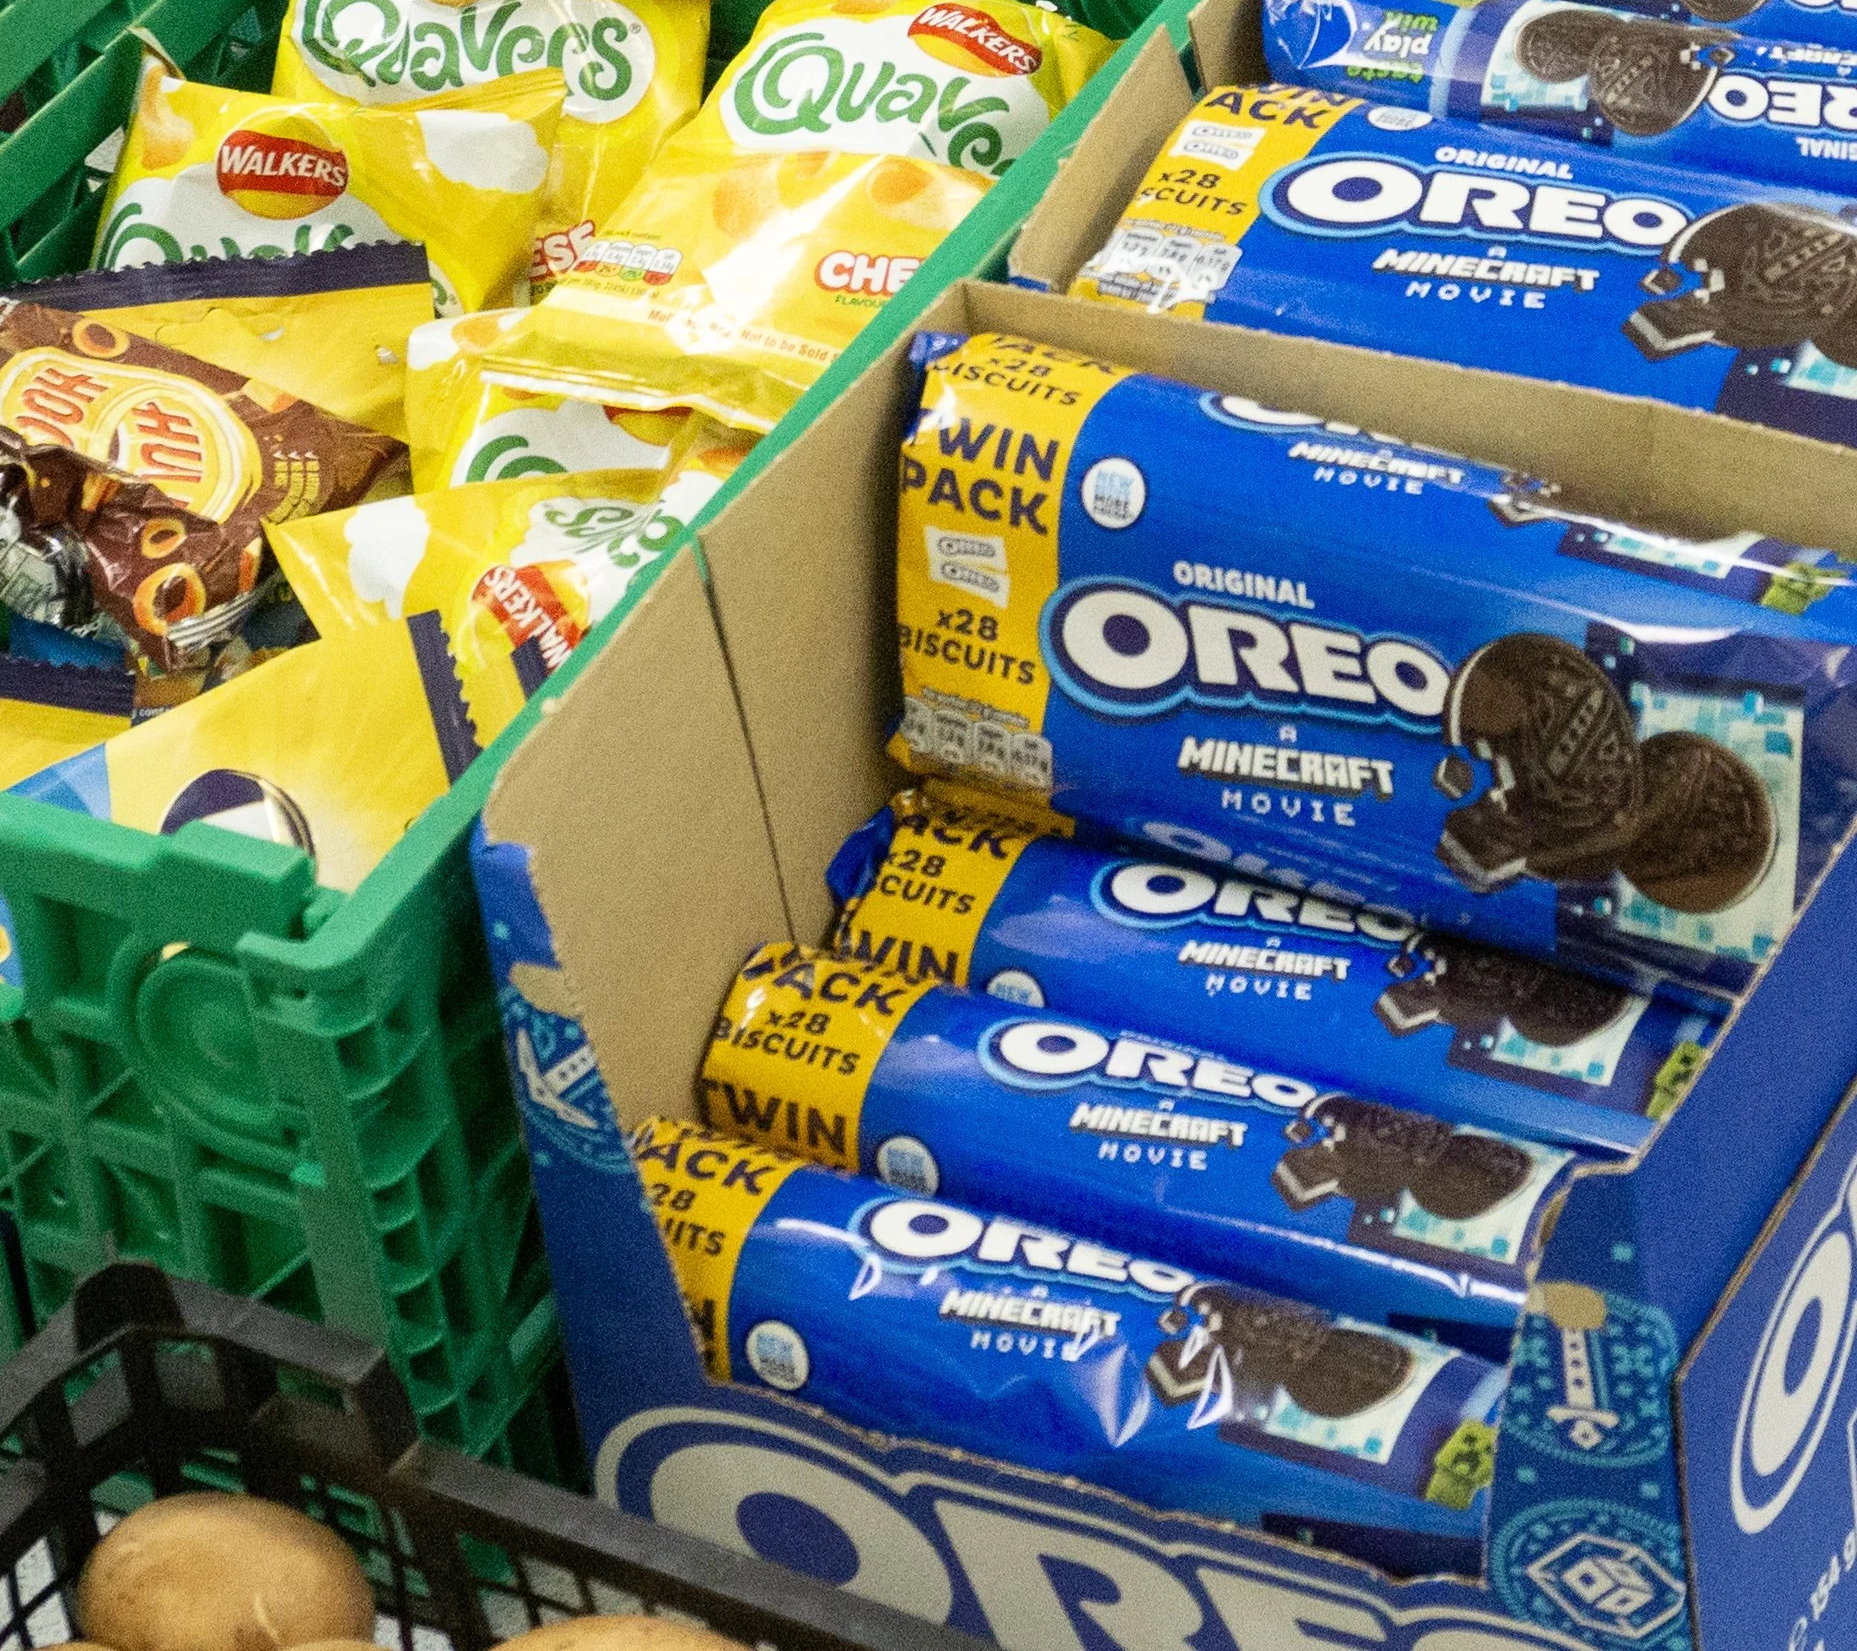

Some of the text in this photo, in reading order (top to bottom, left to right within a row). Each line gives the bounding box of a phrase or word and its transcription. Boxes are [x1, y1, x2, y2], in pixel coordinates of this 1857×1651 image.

[915, 5, 1038, 74] WALKERS
[1362, 28, 1437, 55] play
[1381, 11, 1441, 34] win
[1345, 63, 1425, 85] taste
[733, 32, 1017, 174] Quave
[1203, 91, 1332, 133] ACK
[1709, 74, 1857, 129] REO
[221, 143, 350, 188] WALKERS
[1434, 146, 1575, 181] ORIGINAL
[1796, 135, 1857, 160] GINAL
[1156, 167, 1222, 193] x28
[1284, 158, 1690, 248] OREO
[818, 252, 921, 295] CHE
[1371, 247, 1601, 292] MINECRAFT
[835, 294, 890, 308] FLAVOU
[1404, 280, 1547, 311] MOVIE
[740, 328, 831, 363] Not to be Sold
[986, 354, 1053, 379] x28
[1288, 443, 1467, 486] MINECRAFT
[1312, 468, 1425, 498] MOVIE
[902, 454, 1051, 537] PACK
[1173, 560, 1316, 609] ORIGINAL
[937, 610, 1000, 643] x28
[899, 624, 1037, 687] BISCUITS
[1060, 588, 1453, 718] OREO
[1280, 725, 1298, 744] A
[1176, 736, 1395, 796] MINECRAFT
[1220, 788, 1359, 827] MOVIE
[903, 812, 1012, 861] ACK
[874, 874, 977, 916] CUITS
[1110, 862, 1416, 942] OREO
[842, 919, 961, 988] WIN
[1178, 939, 1351, 981] MINECRAFT
[774, 962, 908, 1017] ACK
[1204, 973, 1314, 1002] MOVIE
[712, 1011, 862, 1076] BISCUITS
[764, 1010, 831, 1038] x28
[999, 1022, 1321, 1109] OREO
[702, 1080, 848, 1158] TWIN
[1070, 1103, 1249, 1147] MINECRAFT
[635, 1140, 777, 1197] ACK
[1097, 1140, 1209, 1172] MOVIE
[649, 1181, 698, 1213] 28
[870, 1200, 1199, 1293] OREO
[939, 1288, 1121, 1339] MINECRAFT
[970, 1329, 1083, 1362] MOVIE
